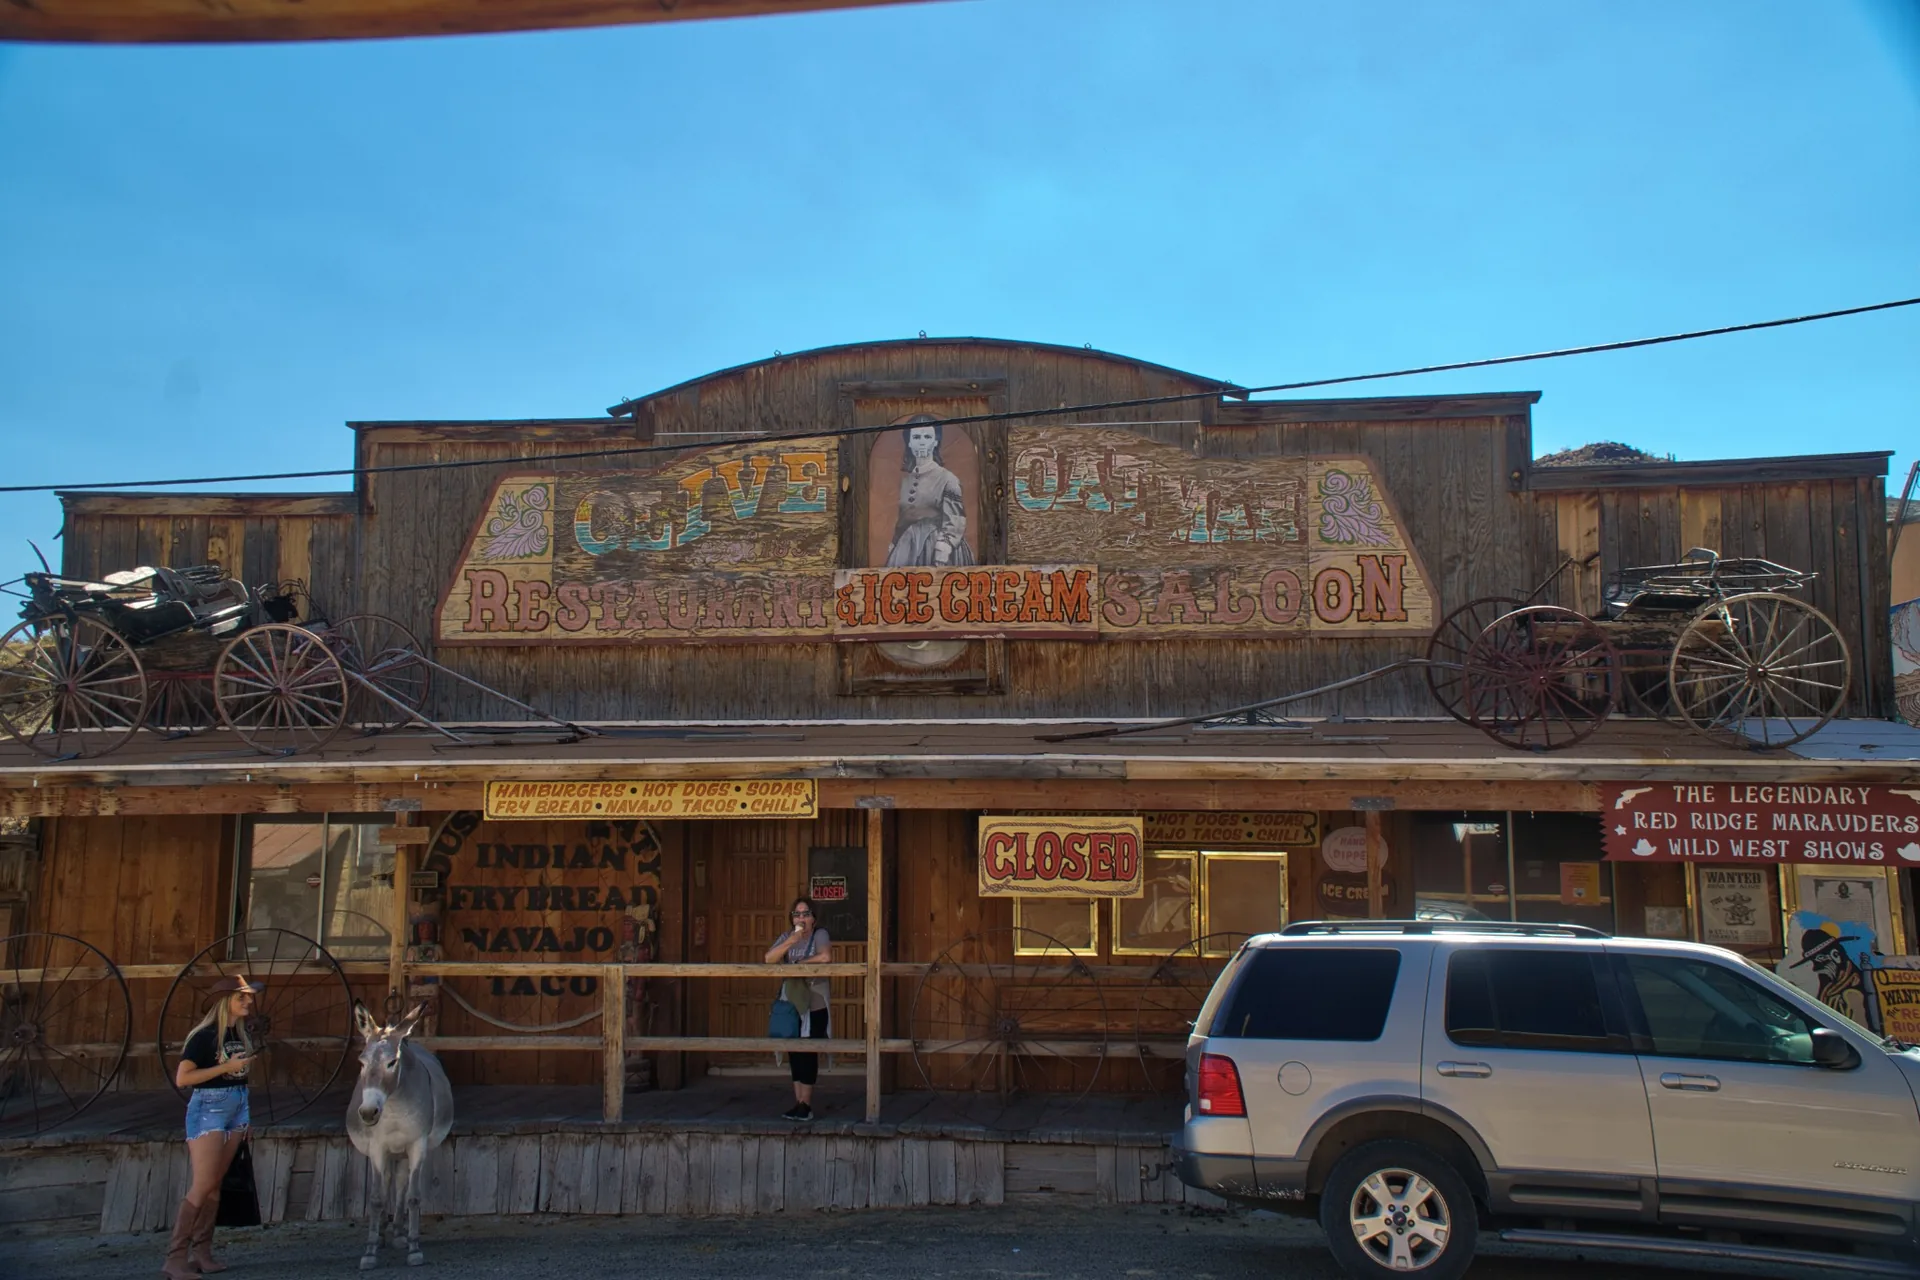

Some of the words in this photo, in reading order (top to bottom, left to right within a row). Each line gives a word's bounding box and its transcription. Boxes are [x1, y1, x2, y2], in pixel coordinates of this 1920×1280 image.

[835, 583, 860, 625] &
[859, 571, 934, 625] ICE
[938, 569, 1093, 625] CREAM
[1103, 554, 1408, 626] SALOON
[462, 568, 833, 633] RESTAURANT
[496, 783, 626, 798] HAMBURGERS
[642, 783, 678, 798] HOT
[682, 782, 730, 797] DOGS
[746, 782, 805, 796] SODAS
[1673, 786, 1715, 804] THE
[1730, 786, 1872, 805] LEGENDARY
[494, 799, 530, 814] FRY
[534, 799, 593, 814] BREAD
[605, 799, 674, 813] NAVAJO
[682, 798, 737, 813] TACOS
[750, 798, 798, 812] CHILI
[1157, 813, 1189, 826] HOT
[1195, 813, 1240, 826] DOGS
[1252, 813, 1306, 827] SODAS
[1634, 812, 1677, 830] RED
[1691, 813, 1758, 831] RIDGE
[1772, 813, 1920, 834] MARAUDERS
[1143, 828, 1185, 841] VAJO
[1192, 828, 1242, 841] TACOS
[1256, 829, 1300, 842] CHILI
[1340, 837, 1367, 846] HAND
[476, 843, 629, 872] INDIAN
[983, 831, 1140, 882] CLOSED
[1333, 849, 1368, 860] DIPPE
[1668, 838, 1720, 857] WILD
[1730, 839, 1790, 858] WEST
[1803, 841, 1885, 861] SHOWS
[1705, 871, 1762, 884] WANTED
[814, 886, 844, 898] CLOSED
[1322, 883, 1344, 898] ICE
[1346, 884, 1389, 900] CREM
[462, 926, 614, 953] NAVAJO
[486, 975, 598, 997] TACO
